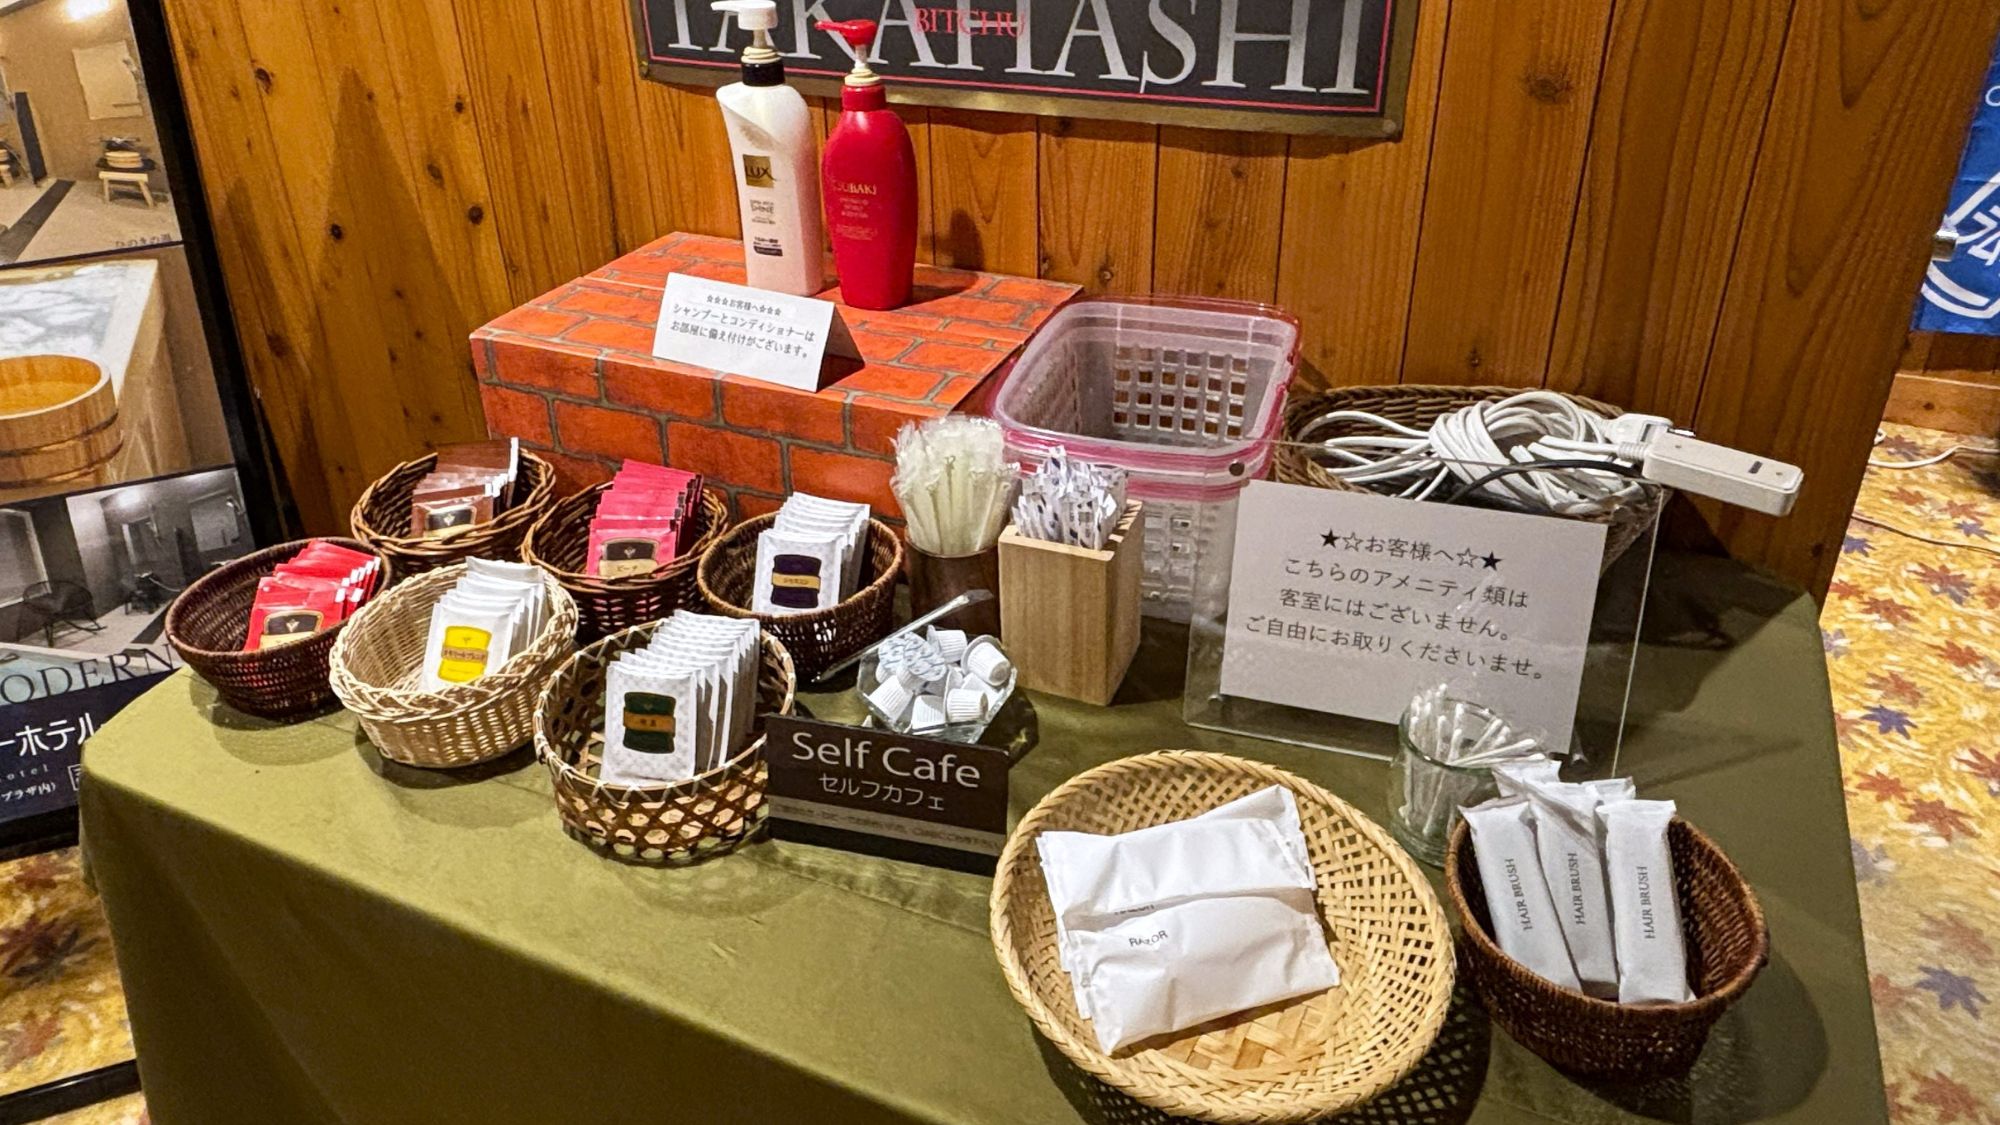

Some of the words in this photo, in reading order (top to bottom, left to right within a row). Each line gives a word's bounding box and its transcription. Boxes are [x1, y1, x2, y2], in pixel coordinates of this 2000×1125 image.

[914, 7, 1025, 37] BITCHU
[745, 166, 776, 181] LUX
[671, 321, 808, 358] お部屋に備え付けがございます。
[673, 304, 815, 342] シャンプーとコンディショナーは
[1285, 558, 1528, 609] こちらのアメニティ類は
[1280, 588, 1509, 641] 客室にはございません。
[1246, 616, 1542, 680] ご自由にお取りくださいませ。
[0, 764, 48, 783] otel
[792, 732, 872, 769] Self
[882, 747, 981, 788] Cafe
[818, 773, 945, 811] セルフカフェ
[1504, 858, 1524, 898] BRUSH
[1567, 853, 1583, 892] BRUSH
[1636, 866, 1651, 904] BRUSH
[1516, 899, 1533, 931] HAIR
[1572, 892, 1586, 925] HAIR
[1639, 906, 1655, 939] HAIR
